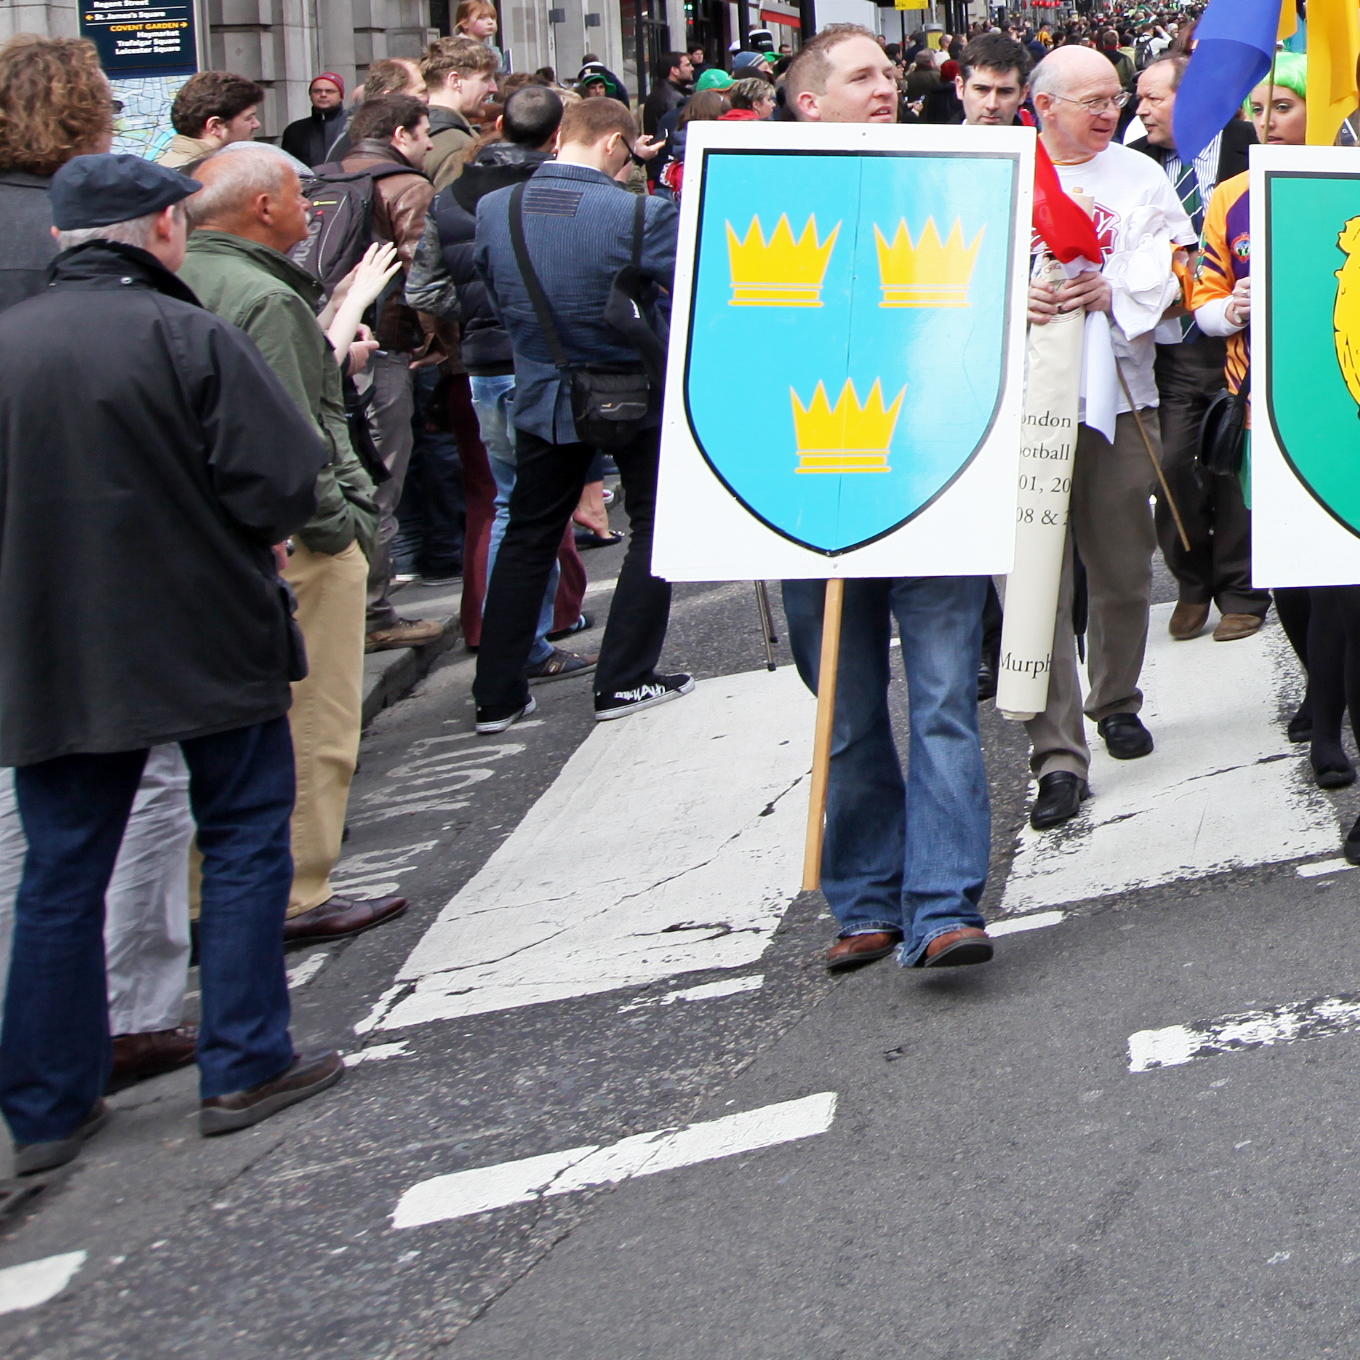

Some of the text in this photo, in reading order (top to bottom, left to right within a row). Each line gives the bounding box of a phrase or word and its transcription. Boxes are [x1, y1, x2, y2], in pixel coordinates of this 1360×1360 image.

[93, 0, 149, 9] Regent Street
[138, 11, 166, 19] Square
[109, 22, 179, 32] COVENT GARDEN
[136, 30, 180, 39] Haymarket
[116, 38, 181, 47] Trafalgar Square
[115, 46, 181, 55] Leicester Square
[1020, 443, 1071, 461] otball
[1019, 474, 1044, 494] 01,
[1041, 509, 1059, 525] &
[1000, 649, 1051, 679] Murph
